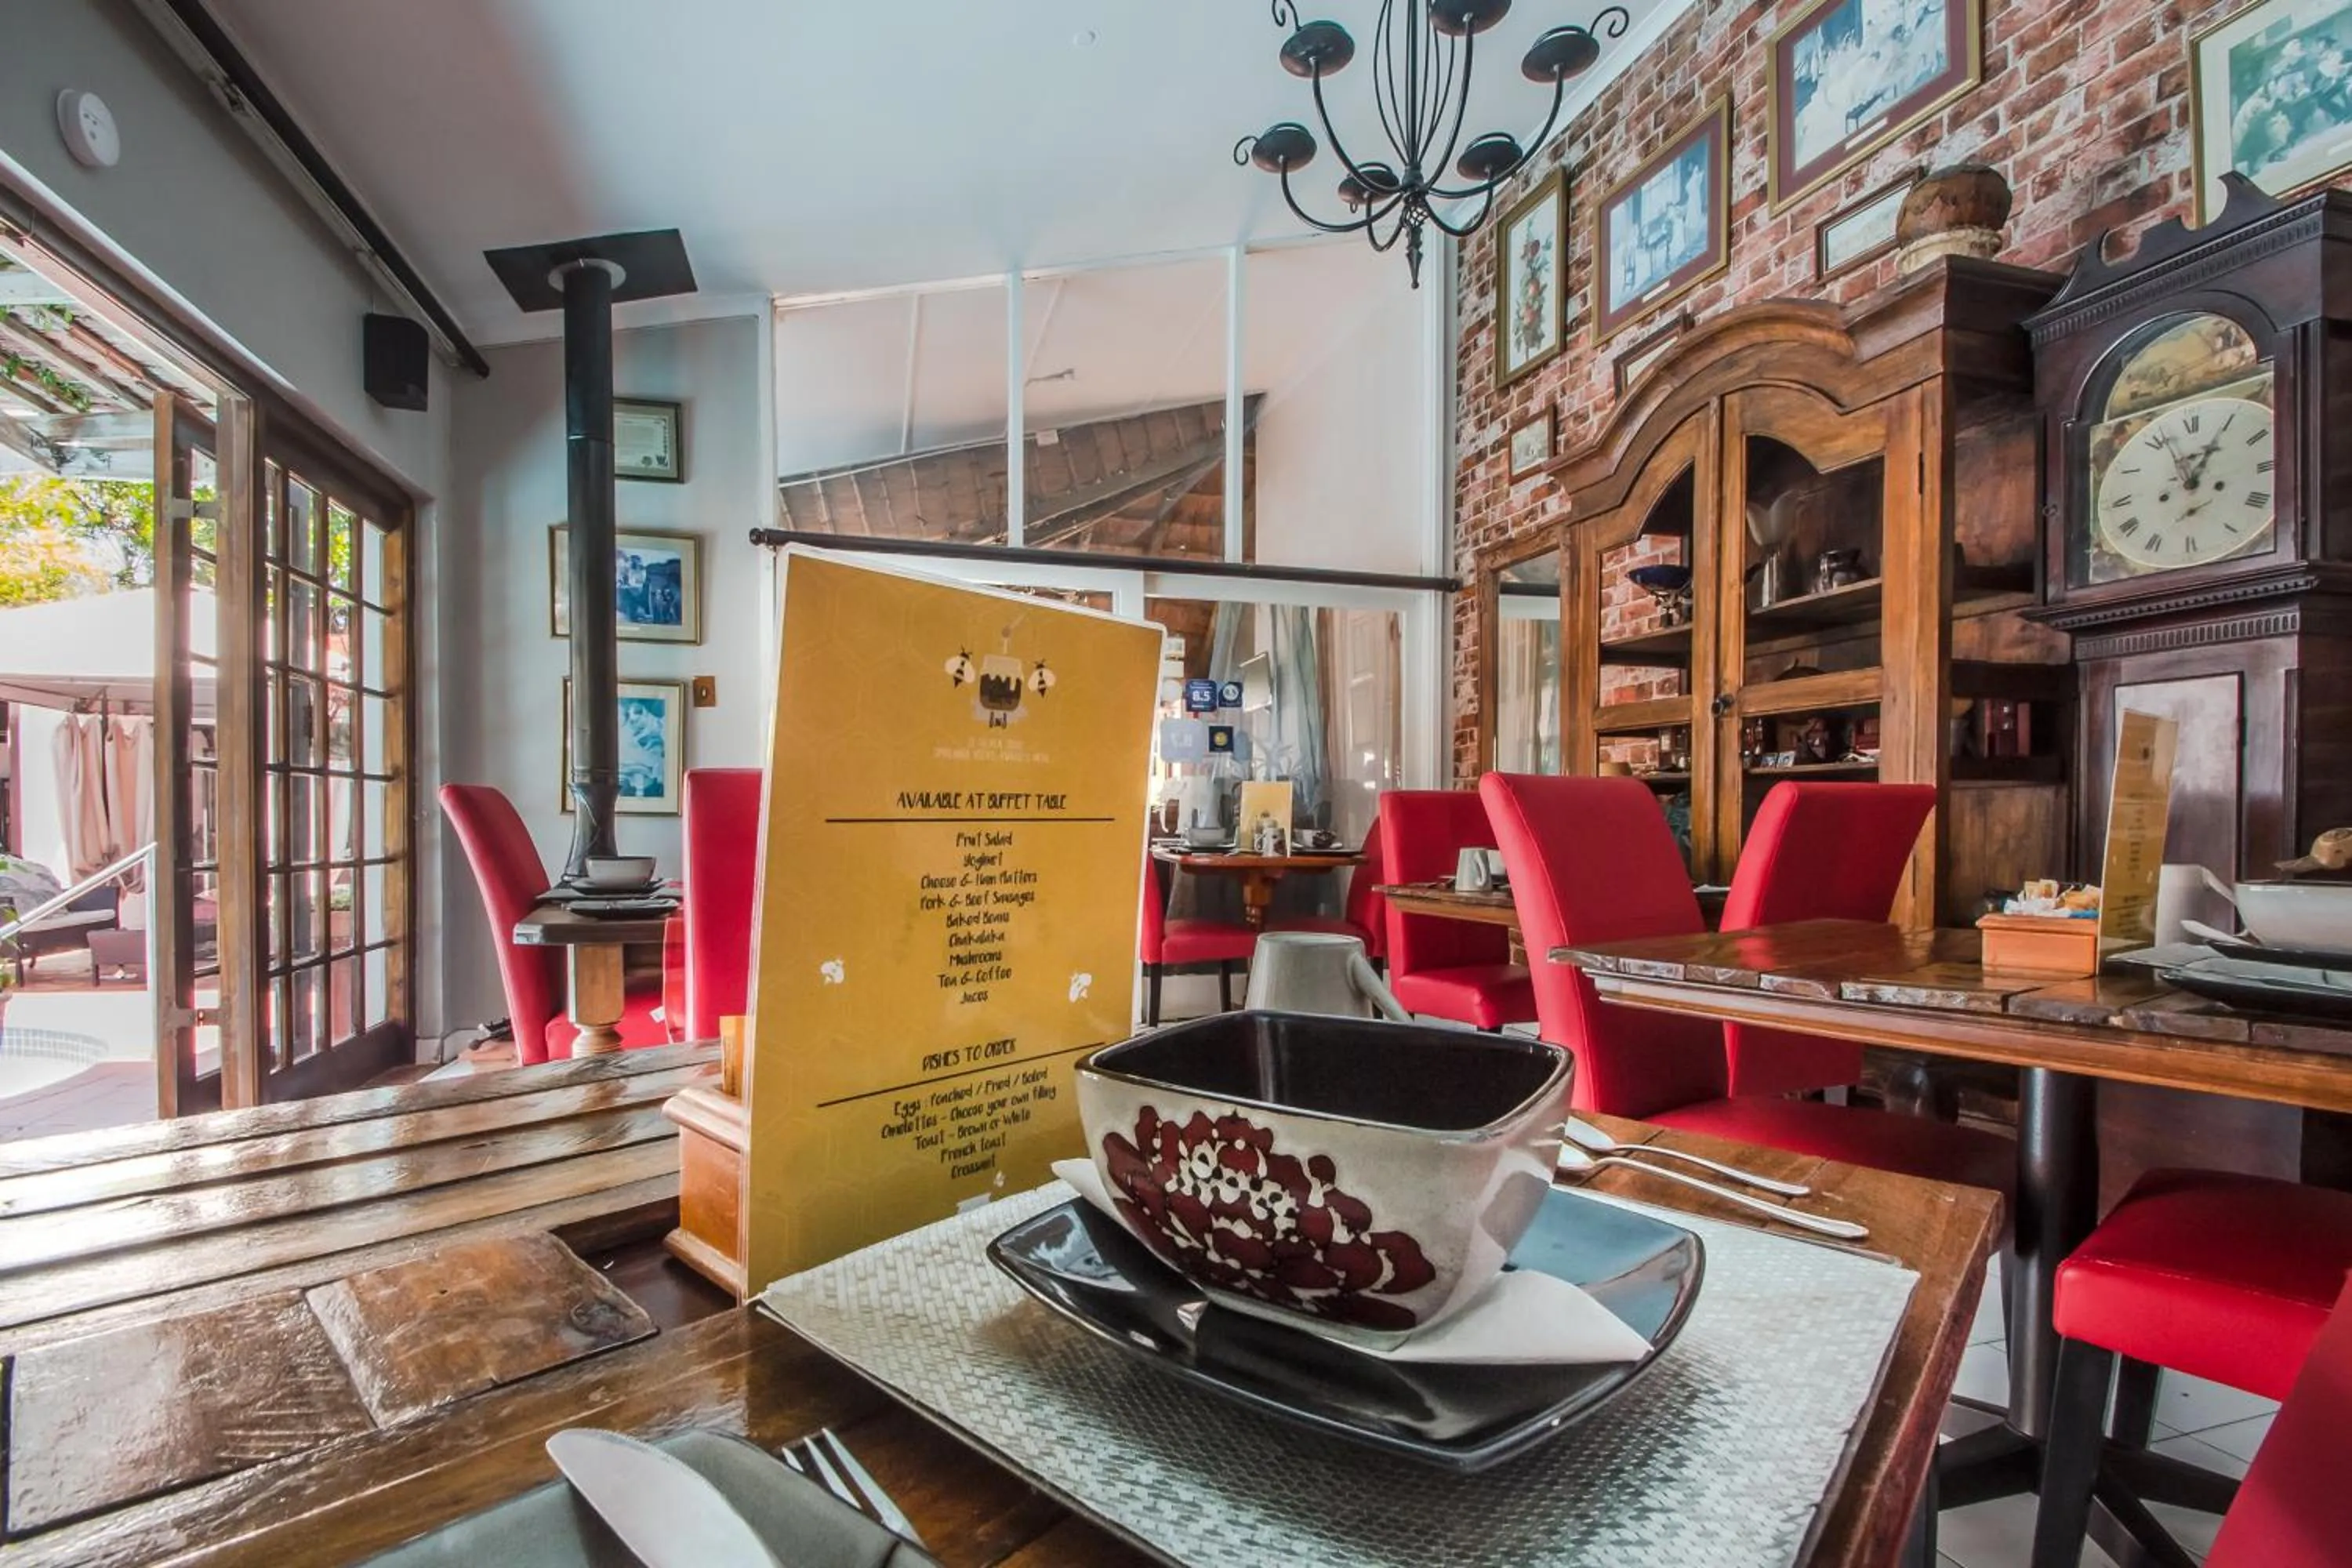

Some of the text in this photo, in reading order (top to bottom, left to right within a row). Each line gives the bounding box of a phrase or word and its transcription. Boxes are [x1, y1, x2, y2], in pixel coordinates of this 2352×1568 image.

[1192, 691, 1211, 702] 8.5
[897, 791, 1067, 811] AVAILABLE AT BUFFET TABLE
[956, 831, 1013, 848] Fruit Salad
[920, 874, 957, 890] Cheese
[960, 873, 972, 887] &
[976, 873, 996, 887] Ham
[920, 890, 1035, 910] Pork & Beef Sausages
[946, 910, 1010, 928] Baked Beans
[949, 949, 1003, 967] Mushrooms
[937, 967, 1012, 988] Tea & Coffee
[922, 1038, 1017, 1072] DISHES TO ORDER
[894, 1099, 922, 1119] Eggs
[931, 1087, 974, 1107] Poached
[984, 1075, 1011, 1094] Fried
[881, 1114, 938, 1139] Omelettes
[949, 1103, 984, 1122] Choose
[986, 1097, 1007, 1116] your
[1011, 1091, 1030, 1106] own
[915, 1130, 945, 1151] Toast
[957, 1123, 988, 1139] Brown
[989, 1119, 999, 1131] or
[940, 1145, 977, 1163] French
